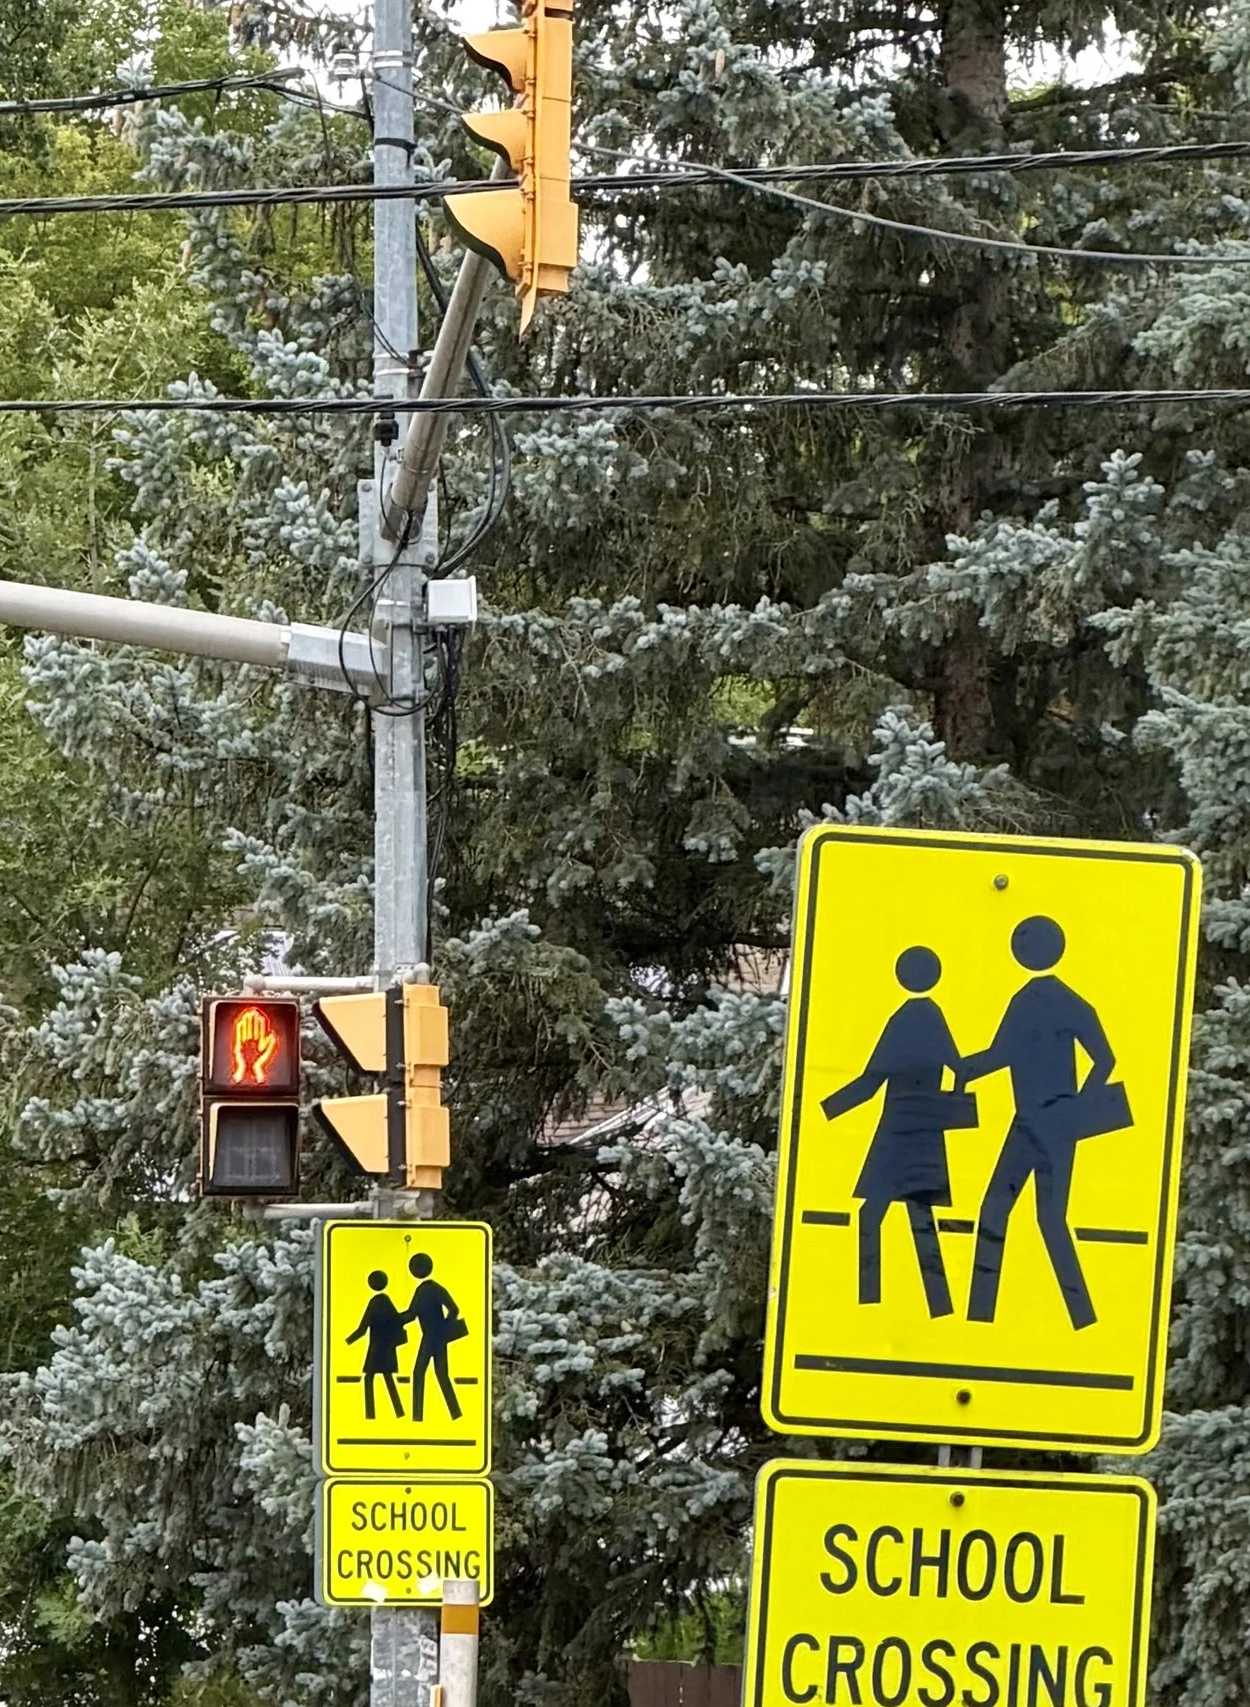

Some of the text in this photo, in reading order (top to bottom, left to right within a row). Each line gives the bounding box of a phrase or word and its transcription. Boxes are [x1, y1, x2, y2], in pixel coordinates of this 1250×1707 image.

[351, 1501, 467, 1532] SCHOOL
[337, 1549, 481, 1580] CROSSING
[820, 1523, 1086, 1605] SCHOOL
